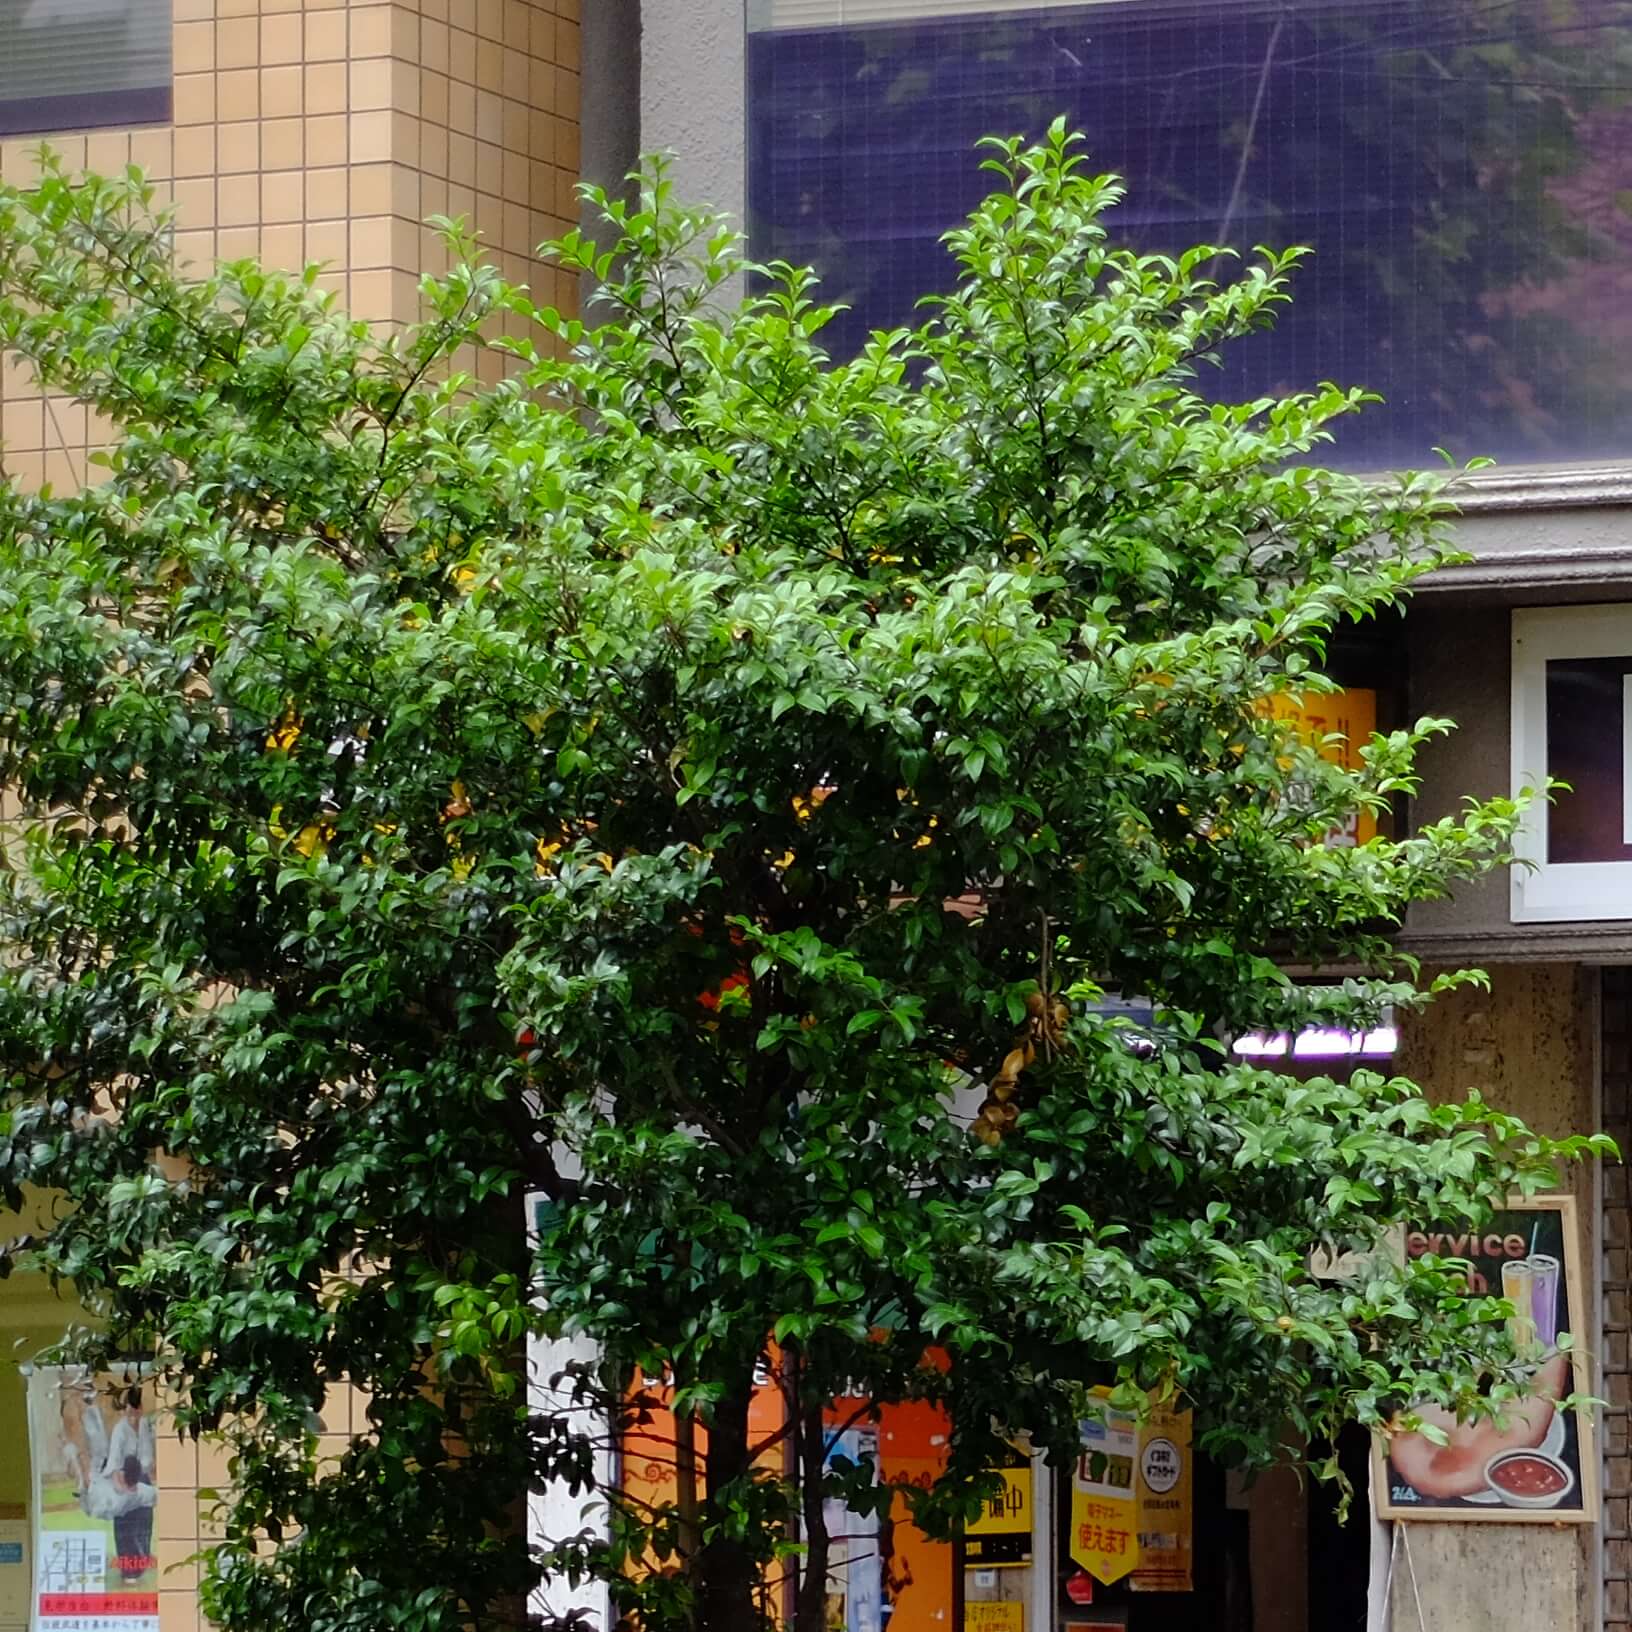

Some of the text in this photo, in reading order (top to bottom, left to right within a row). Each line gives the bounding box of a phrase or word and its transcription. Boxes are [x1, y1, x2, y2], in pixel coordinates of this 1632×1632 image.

[1406, 1230, 1528, 1259] ervice
[1078, 1522, 1131, 1556] 使えます
